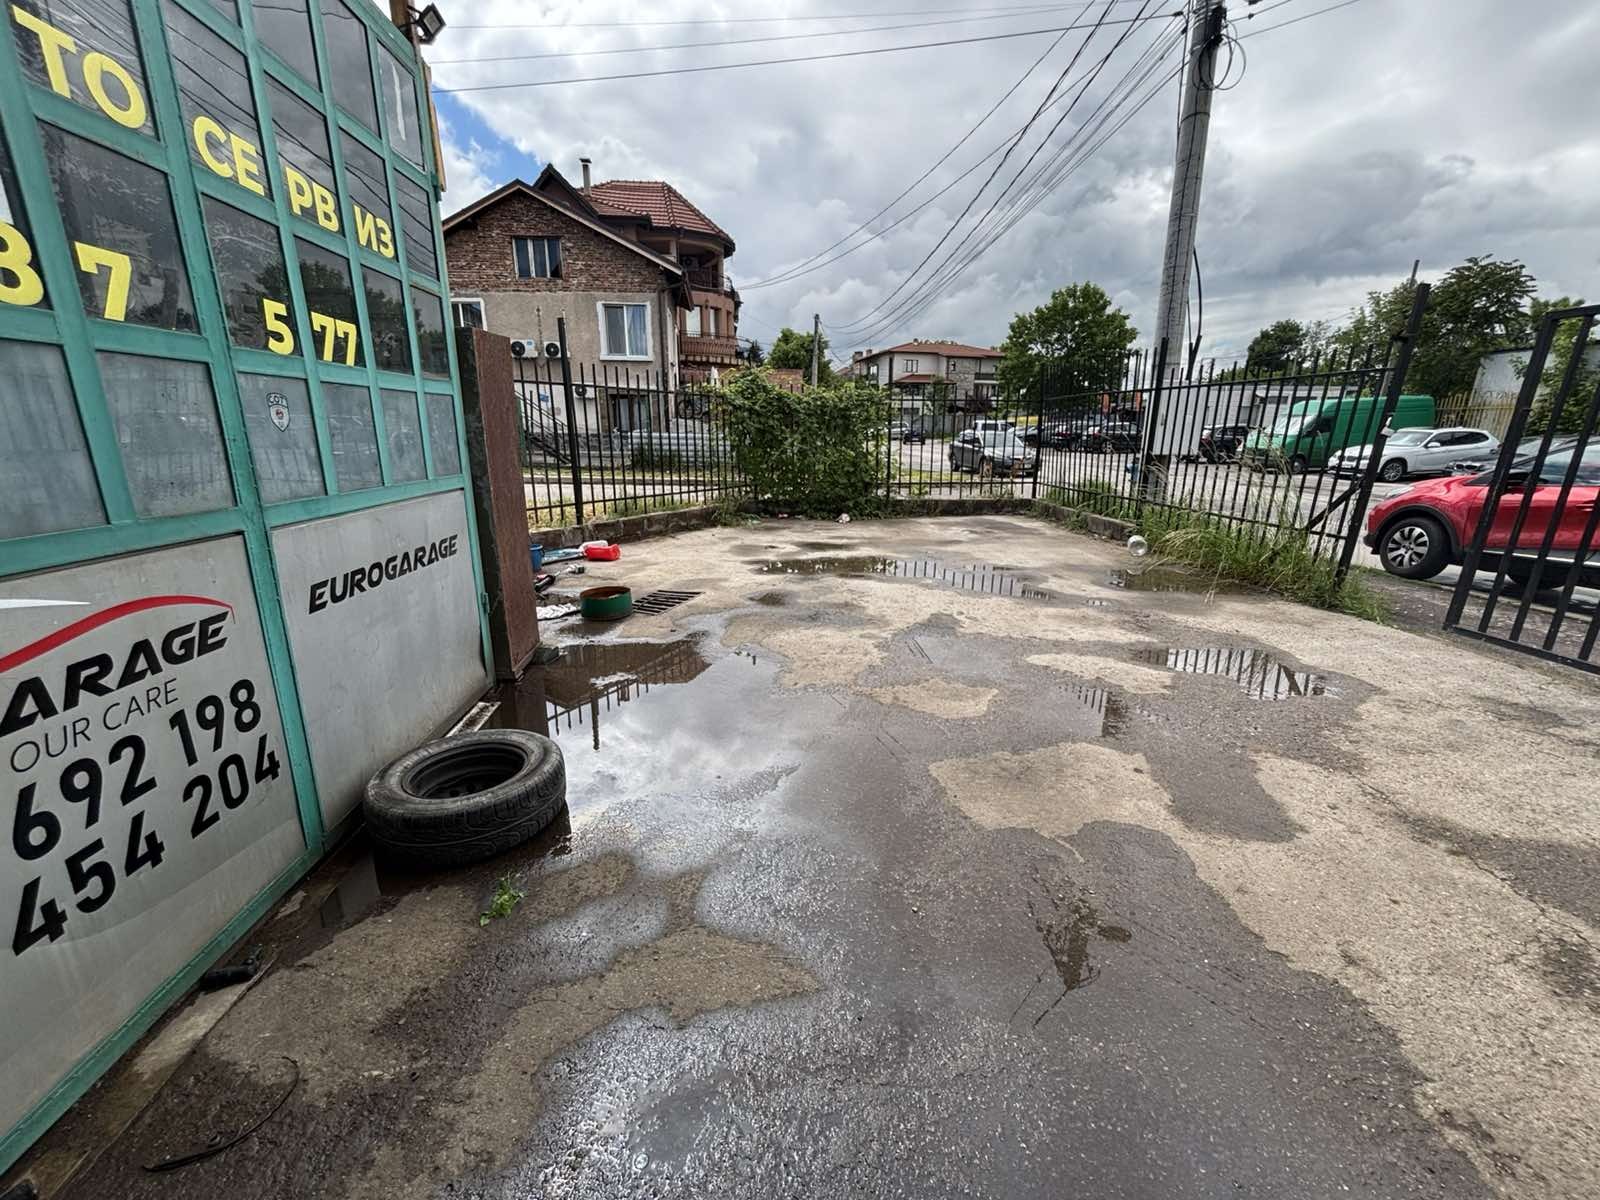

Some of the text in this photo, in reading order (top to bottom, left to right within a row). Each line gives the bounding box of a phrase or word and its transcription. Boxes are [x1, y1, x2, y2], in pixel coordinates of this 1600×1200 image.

[309, 534, 458, 615] EUROGARAGE
[0, 611, 229, 737] ARAGE
[10, 678, 178, 773] OUR CARE
[12, 679, 261, 861] 692 198
[11, 733, 281, 957] 454 204
